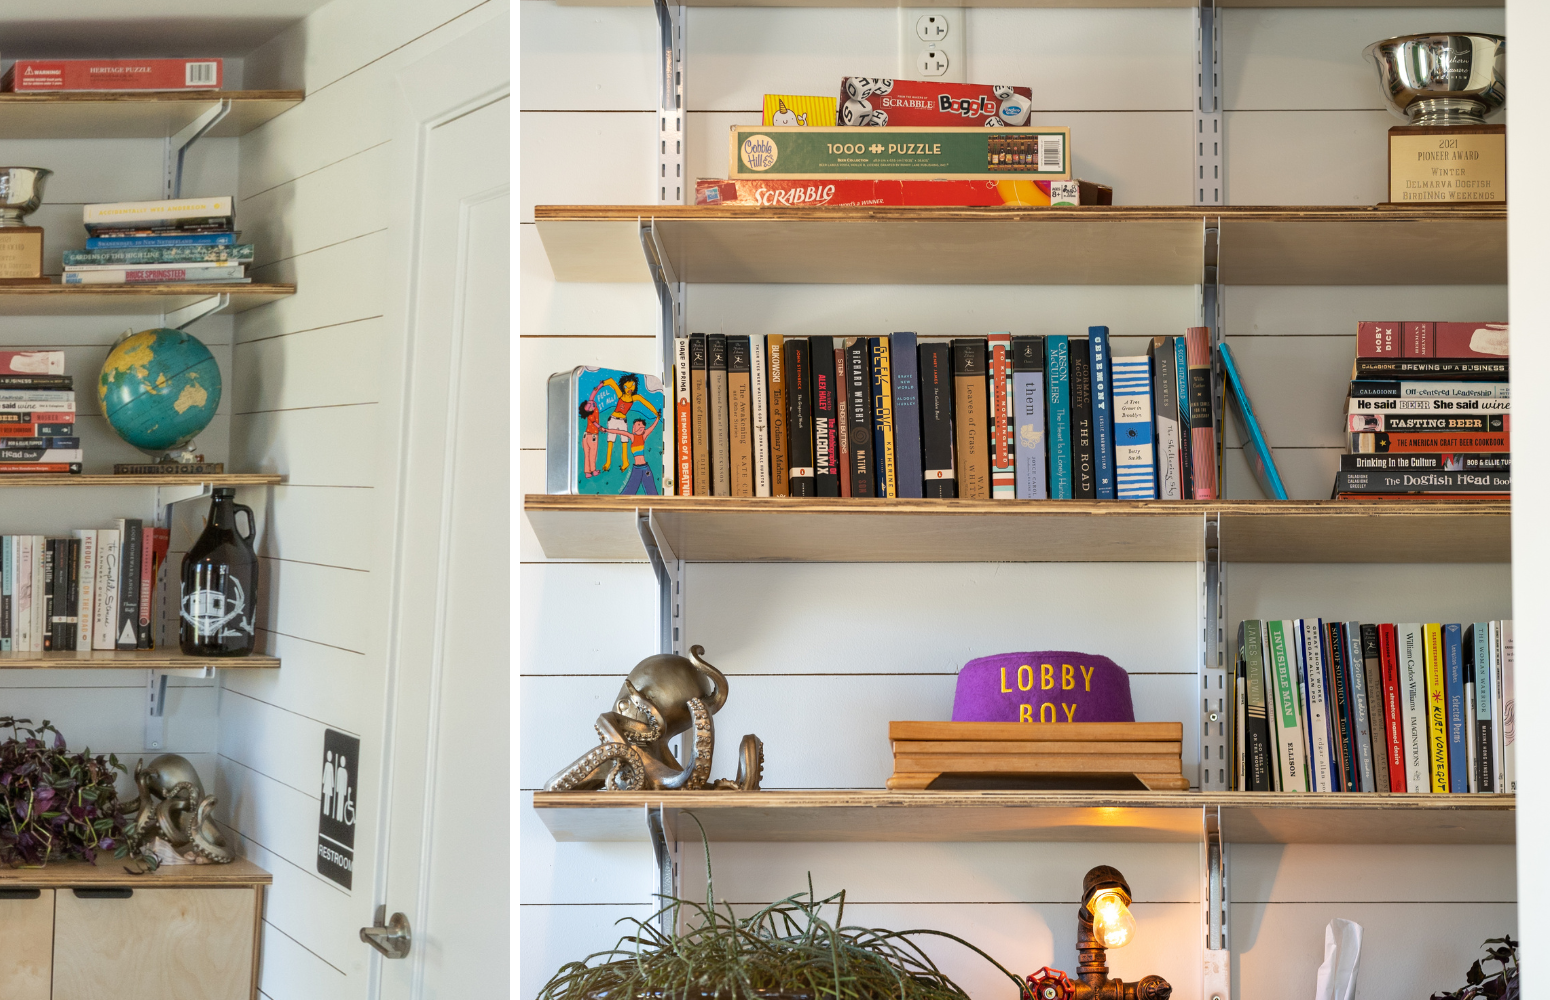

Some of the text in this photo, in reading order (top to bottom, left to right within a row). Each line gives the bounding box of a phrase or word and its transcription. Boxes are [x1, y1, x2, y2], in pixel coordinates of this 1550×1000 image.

[881, 94, 996, 118] SCRABBLE Boggle
[745, 140, 772, 154] Cobble
[828, 144, 941, 154] 1000 PUZZLE
[1439, 140, 1458, 148] 2021
[748, 154, 762, 168] Hill
[1418, 151, 1479, 161] PIONEER AWARD
[1431, 168, 1465, 176] WINTER
[1406, 180, 1491, 188] DELMARVA DOGFISH
[755, 185, 835, 205] SCRABBLE
[1449, 191, 1494, 199] WEEKENDS
[99, 208, 147, 216] ACCIDENTALLY
[145, 269, 186, 278] SPRINGSTEEN
[1058, 342, 1067, 381] CARSON
[1050, 349, 1059, 404] McCULLERS
[1095, 337, 1105, 410] CEREMONY
[818, 374, 827, 411] ALEX HALEY
[1025, 383, 1036, 416] them
[772, 345, 783, 485] BUKOWSKI Tales of Ordinary Madness
[852, 350, 866, 474] RICHARD WRIGHT NATIVE
[1357, 400, 1511, 410] He said BEER She said wine
[1390, 419, 1482, 428] TASTING BEER
[816, 418, 828, 467] MALCOLM
[2, 450, 22, 458] Head
[1080, 420, 1089, 491] THE ROAD
[1356, 458, 1387, 469] Drinking
[1397, 458, 1408, 467] the
[1411, 457, 1436, 467] Culture
[1385, 474, 1491, 486] The Dogfish Head
[84, 537, 92, 569] KEROUAC
[103, 554, 115, 592] Complete
[83, 586, 89, 595] ON
[1000, 664, 1094, 693] LOBBY
[1273, 631, 1293, 716] INVISIBLE MAN
[1406, 633, 1417, 711] William Carlos Williams
[1019, 702, 1077, 722] BOY
[1452, 695, 1461, 743] Selected Poems
[1433, 706, 1446, 791] KURT VONNEGUT
